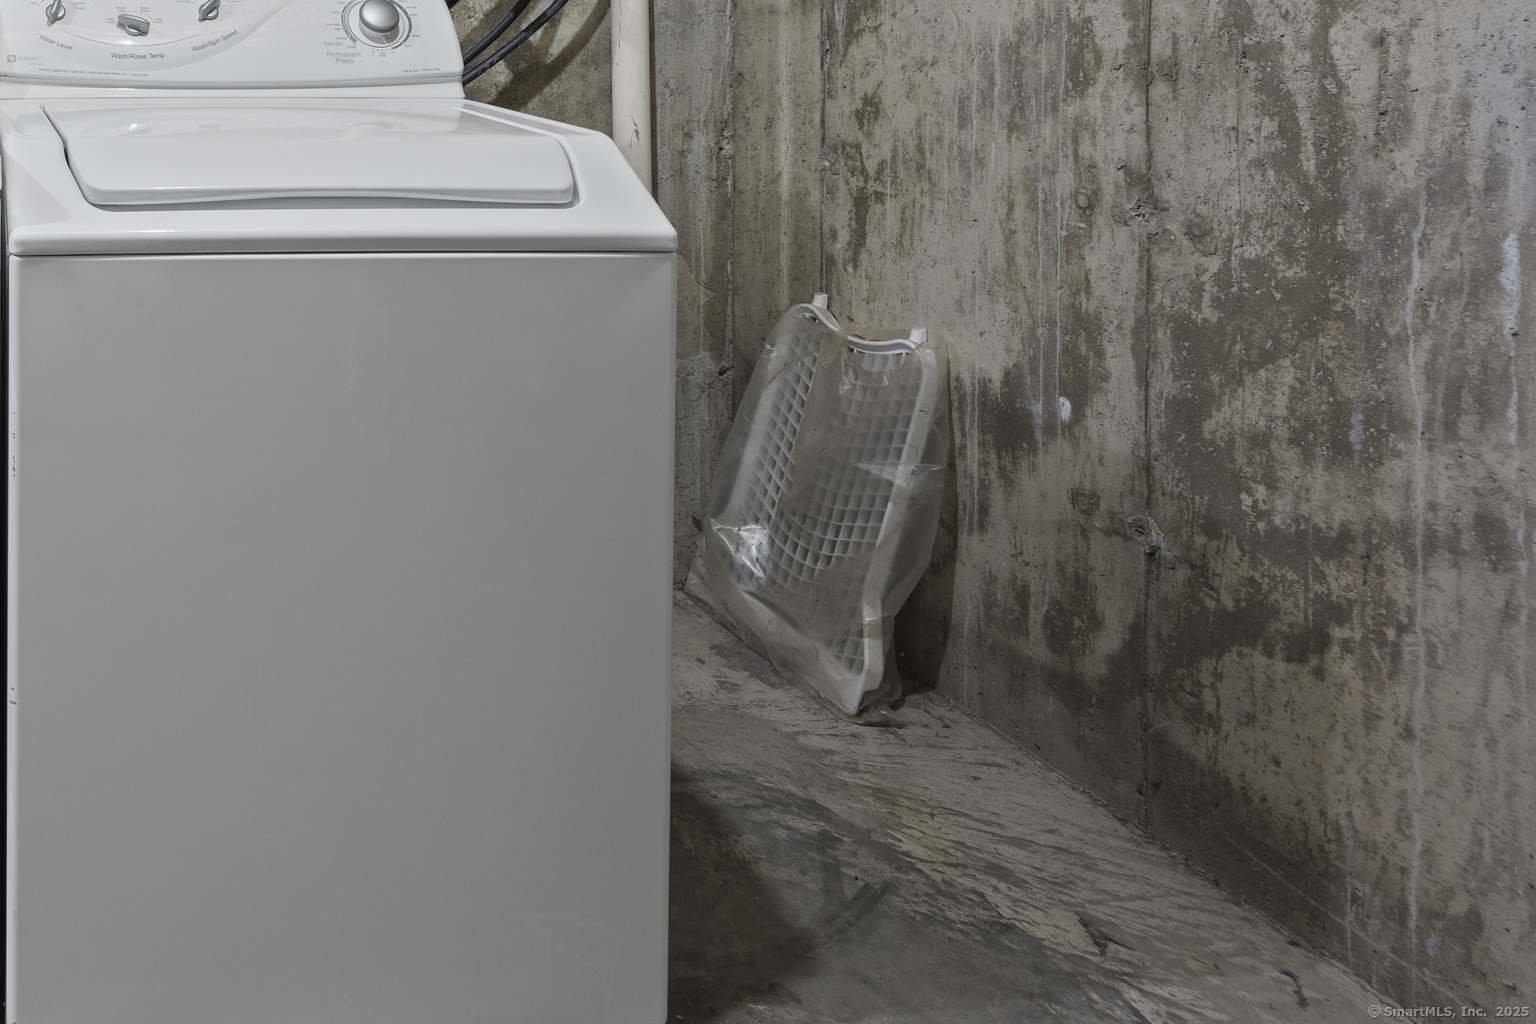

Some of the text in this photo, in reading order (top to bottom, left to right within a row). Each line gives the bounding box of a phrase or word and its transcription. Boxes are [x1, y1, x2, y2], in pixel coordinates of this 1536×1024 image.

[38, 33, 73, 51] Water Level
[191, 29, 239, 52] Wash/Spin Speed
[110, 52, 166, 60] Wash/Rinse Temp
